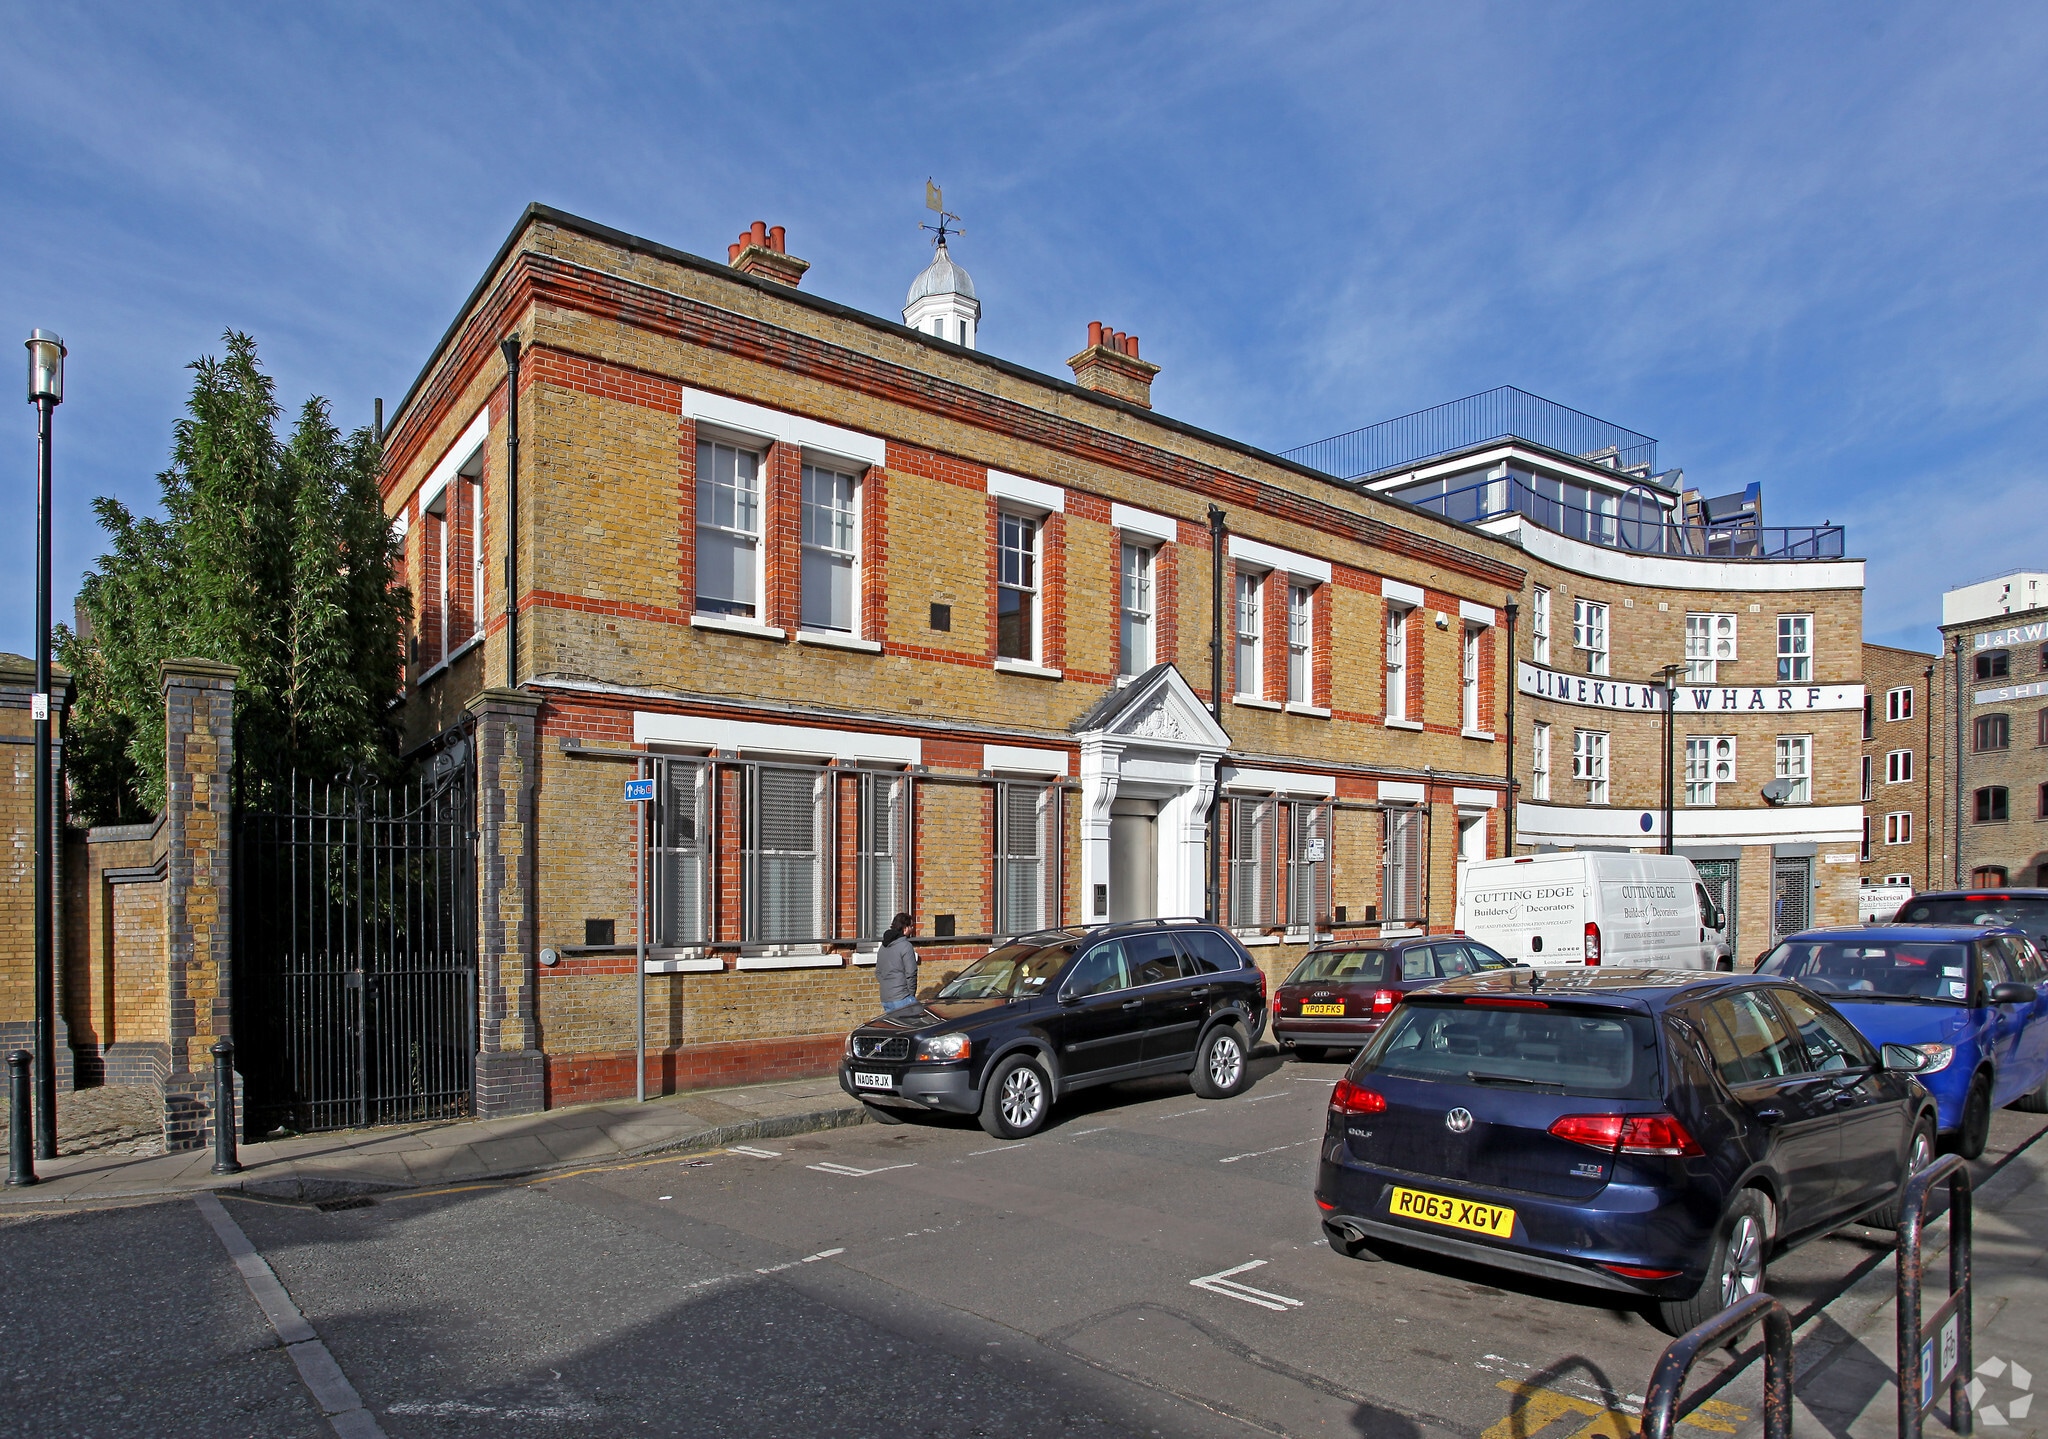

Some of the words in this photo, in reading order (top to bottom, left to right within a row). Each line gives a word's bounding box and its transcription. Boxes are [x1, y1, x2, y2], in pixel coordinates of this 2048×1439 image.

[1536, 670, 1654, 709] LIMEKILN
[1691, 688, 1821, 710] WHARF
[1474, 890, 1532, 904] CUTTING
[1537, 887, 1574, 898] EDGE
[1622, 885, 1655, 899] CUTTING
[1656, 885, 1676, 899] EDGE
[1867, 894, 1904, 902] Electrical
[1474, 907, 1509, 917] Builders
[1526, 903, 1575, 913] Decorators
[1624, 907, 1645, 918] Builders
[1652, 907, 1679, 917] Decorators
[1305, 1004, 1325, 1013] YP03
[1325, 1004, 1341, 1013] FKS
[857, 1074, 873, 1085] NA06
[875, 1076, 889, 1086] RJX
[1348, 1127, 1373, 1138] GOLF
[1577, 1162, 1603, 1173] TDI
[1399, 1191, 1453, 1220] RO63
[1457, 1202, 1503, 1230] XGV
